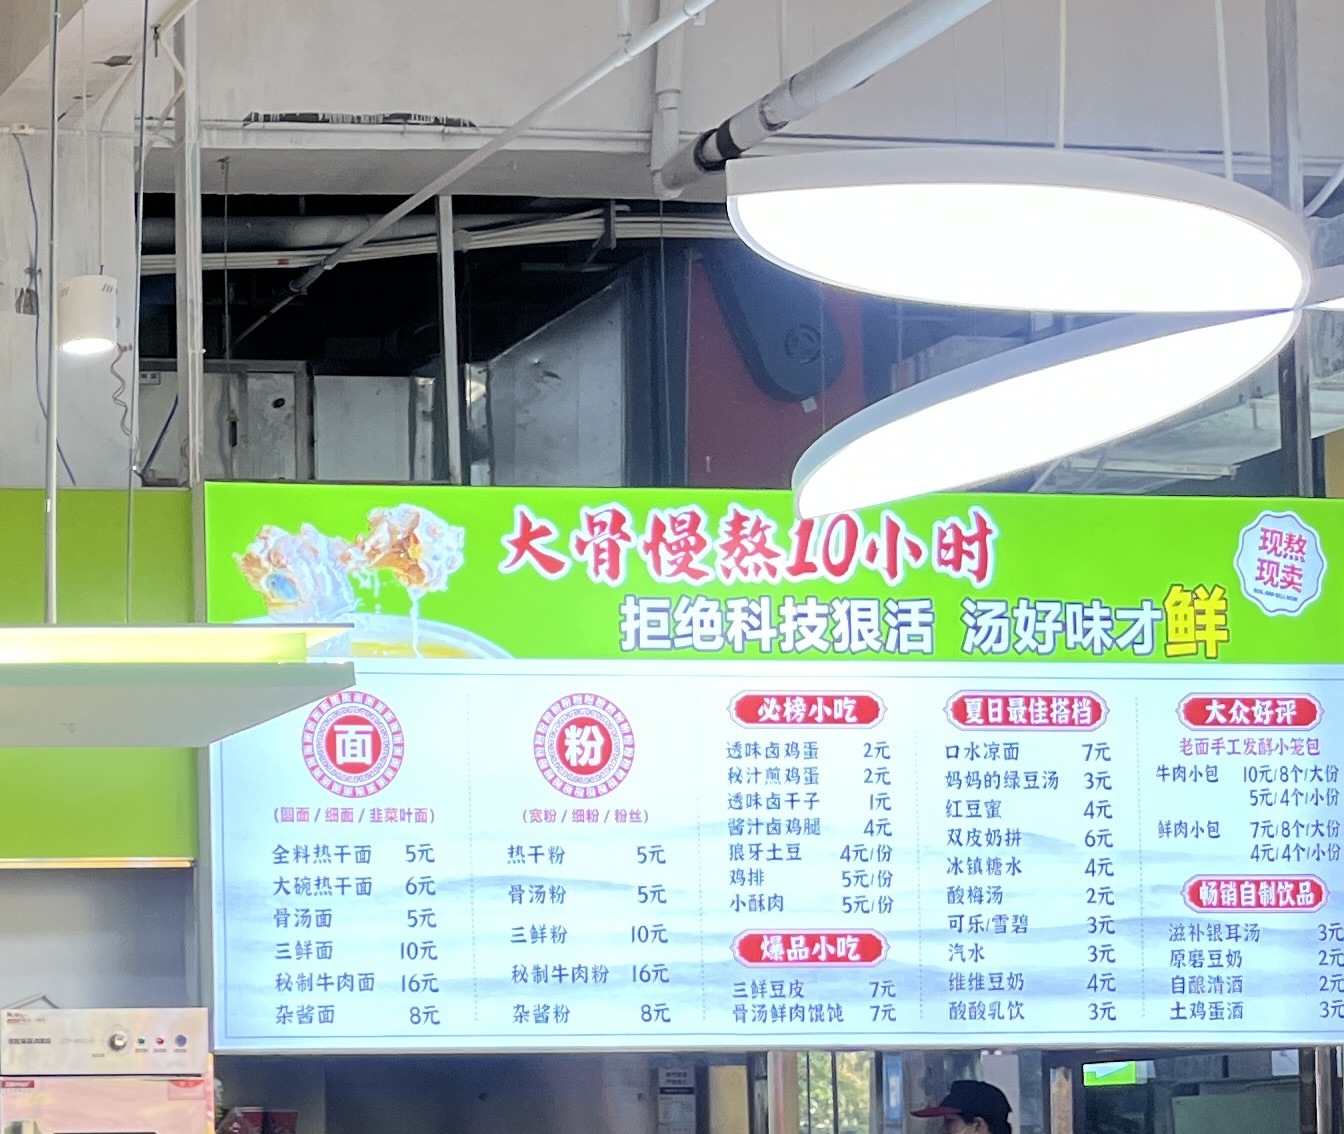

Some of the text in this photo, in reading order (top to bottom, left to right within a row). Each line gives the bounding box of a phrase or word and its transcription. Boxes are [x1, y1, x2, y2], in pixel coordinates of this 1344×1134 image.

[503, 505, 994, 584] 大骨慢熬10小时
[1258, 526, 1307, 562] 现熬
[1255, 558, 1303, 593] 现卖
[619, 584, 1230, 659] 拒绝科技狠活 汤好味才鲜
[757, 696, 858, 724] 必榜小吃
[963, 696, 1093, 726] 夏日最佳搭档
[1204, 698, 1298, 725] 大众好评
[333, 724, 374, 766] 面
[563, 724, 605, 767] 粉
[726, 740, 891, 760] 透味卤鸡蛋 2元
[944, 741, 1112, 762] 口水凉面 7元
[863, 766, 892, 786] 2元
[944, 770, 1113, 791] 妈妈的绿豆汤 3元
[1155, 763, 1340, 784] 牛肉小包 10元/8个/大份
[727, 791, 892, 812] 透味卤干子 1元
[1249, 787, 1341, 807] 5元/4个/小份
[1082, 799, 1114, 820] 4元
[727, 817, 893, 837] 酱汁卤鸡腿 4元
[946, 827, 1114, 849] 双皮奶拼 6元
[1157, 818, 1341, 839] 鲜肉小包 7元/8个/大份
[271, 843, 436, 865] 全料热干面 5元
[507, 844, 667, 865] 热干粉 5元
[728, 842, 893, 863] 狼牙土豆 4元/份
[1249, 842, 1342, 863] 4元/4个/小份
[729, 867, 894, 889] 鸡排 5元/份
[1083, 857, 1115, 878] 4元
[272, 875, 437, 897] 大碗热干面 6元
[507, 882, 668, 905] 骨汤粉 5元
[946, 885, 1115, 906] 酸梅汤 2元
[1198, 880, 1315, 908] 畅销自制饮品
[729, 893, 895, 915] 小酥肉 5元/份
[273, 907, 438, 929] 骨汤面 5元
[947, 913, 1117, 935] 可乐/雪碧 3元
[509, 923, 669, 945] 三鲜粉 10元
[1168, 921, 1344, 943] 滋补银耳汤 3元
[274, 939, 439, 961] 三鲜面 10元
[760, 934, 861, 962] 爆品小吃
[948, 942, 1117, 964] 汽水 3元
[1169, 947, 1344, 969] 原磨豆奶 2元
[274, 971, 440, 993] 秘制牛肉面 16元
[510, 963, 671, 985] 秘制牛肉粉 16元
[946, 971, 1117, 994] 维维豆奶 4元
[1318, 973, 1344, 994] 2元
[731, 978, 897, 1000] 三鲜豆皮 7元
[275, 1004, 441, 1026] 杂酱面 8元
[512, 1002, 672, 1024] 杂酱粉 8元
[732, 1002, 897, 1024] 骨汤鲜肉馄饨 7元
[948, 1000, 1117, 1022] 酸酸乳饮 3元
[1169, 999, 1344, 1021] 土鸡蛋酒 3元
